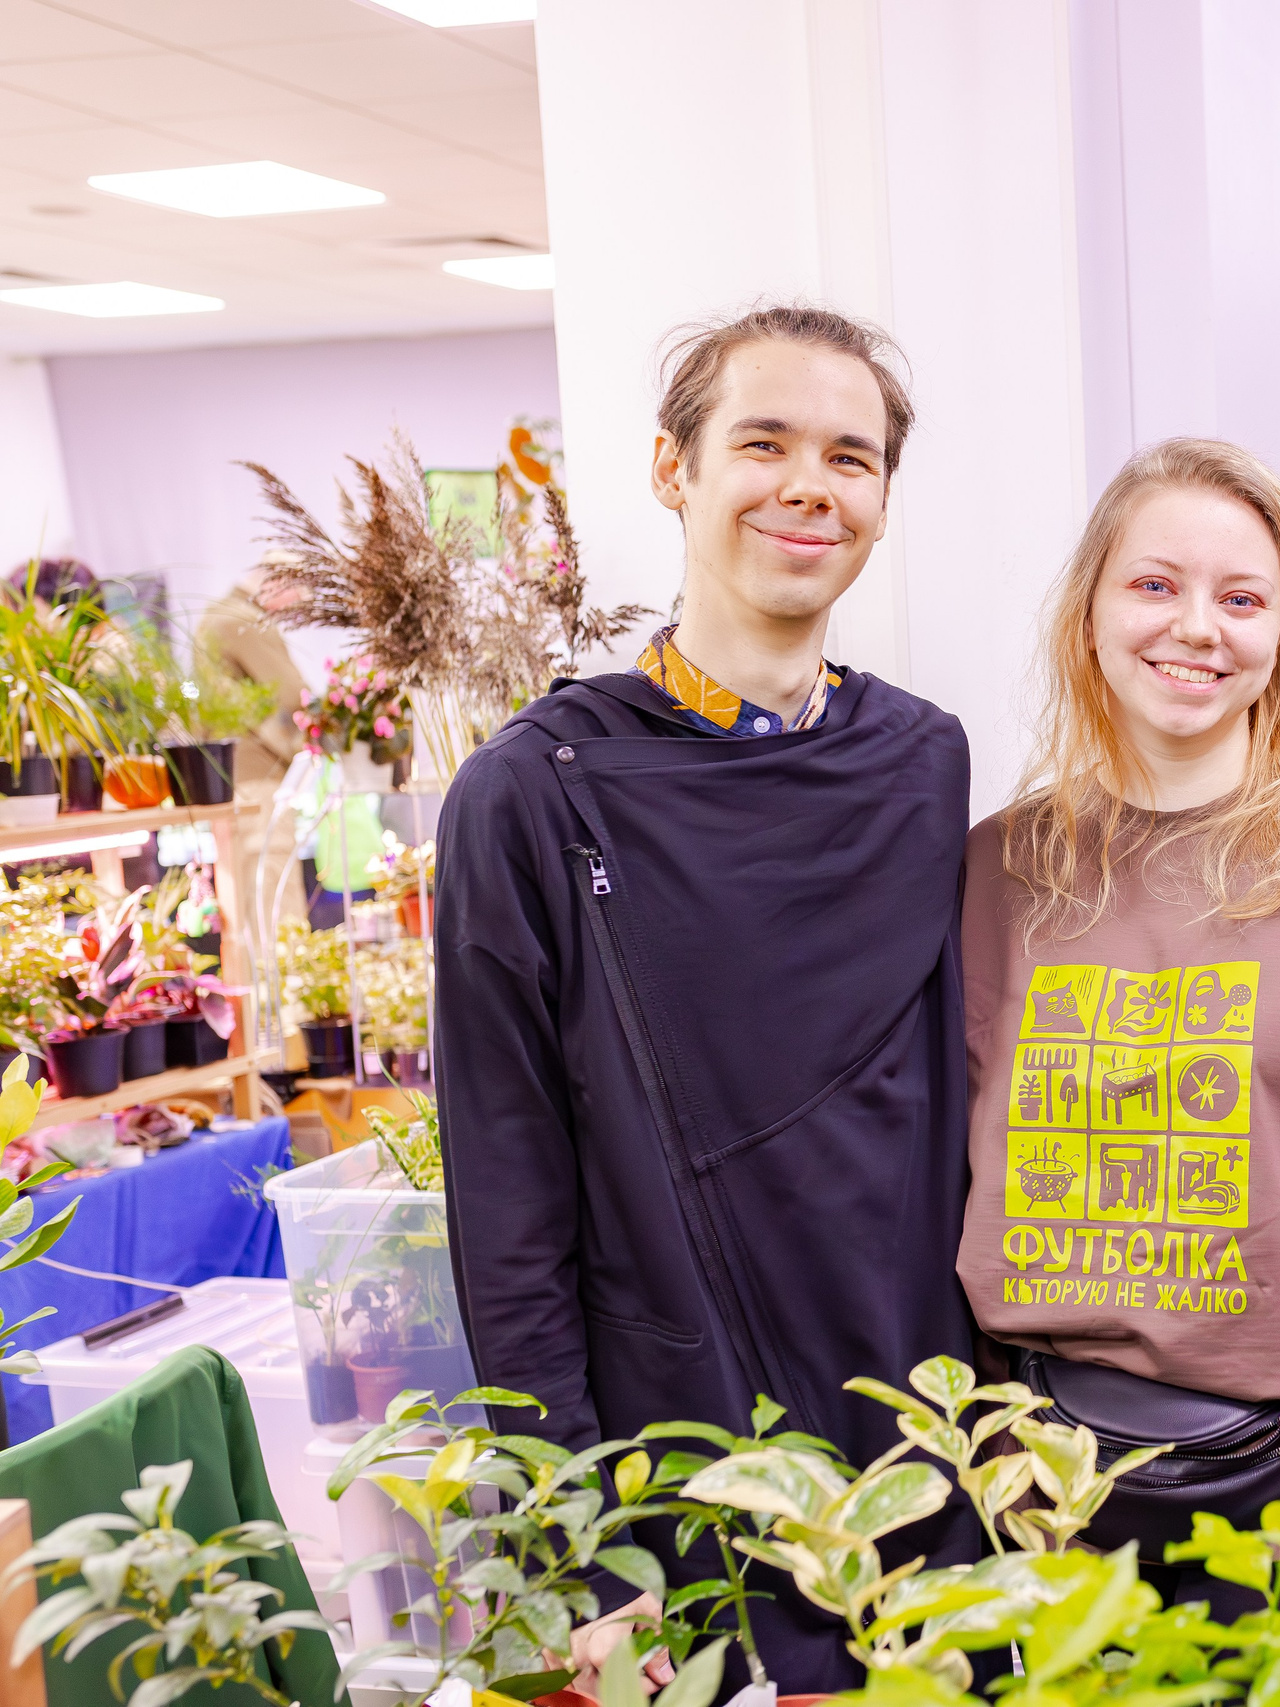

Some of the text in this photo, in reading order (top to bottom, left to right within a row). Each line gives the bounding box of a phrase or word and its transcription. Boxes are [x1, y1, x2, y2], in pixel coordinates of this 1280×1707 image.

[1002, 1224, 1248, 1282] ФУТБОЛКА
[1115, 1281, 1146, 1308] НЕ
[1154, 1283, 1248, 1315] ЖАЛКО
